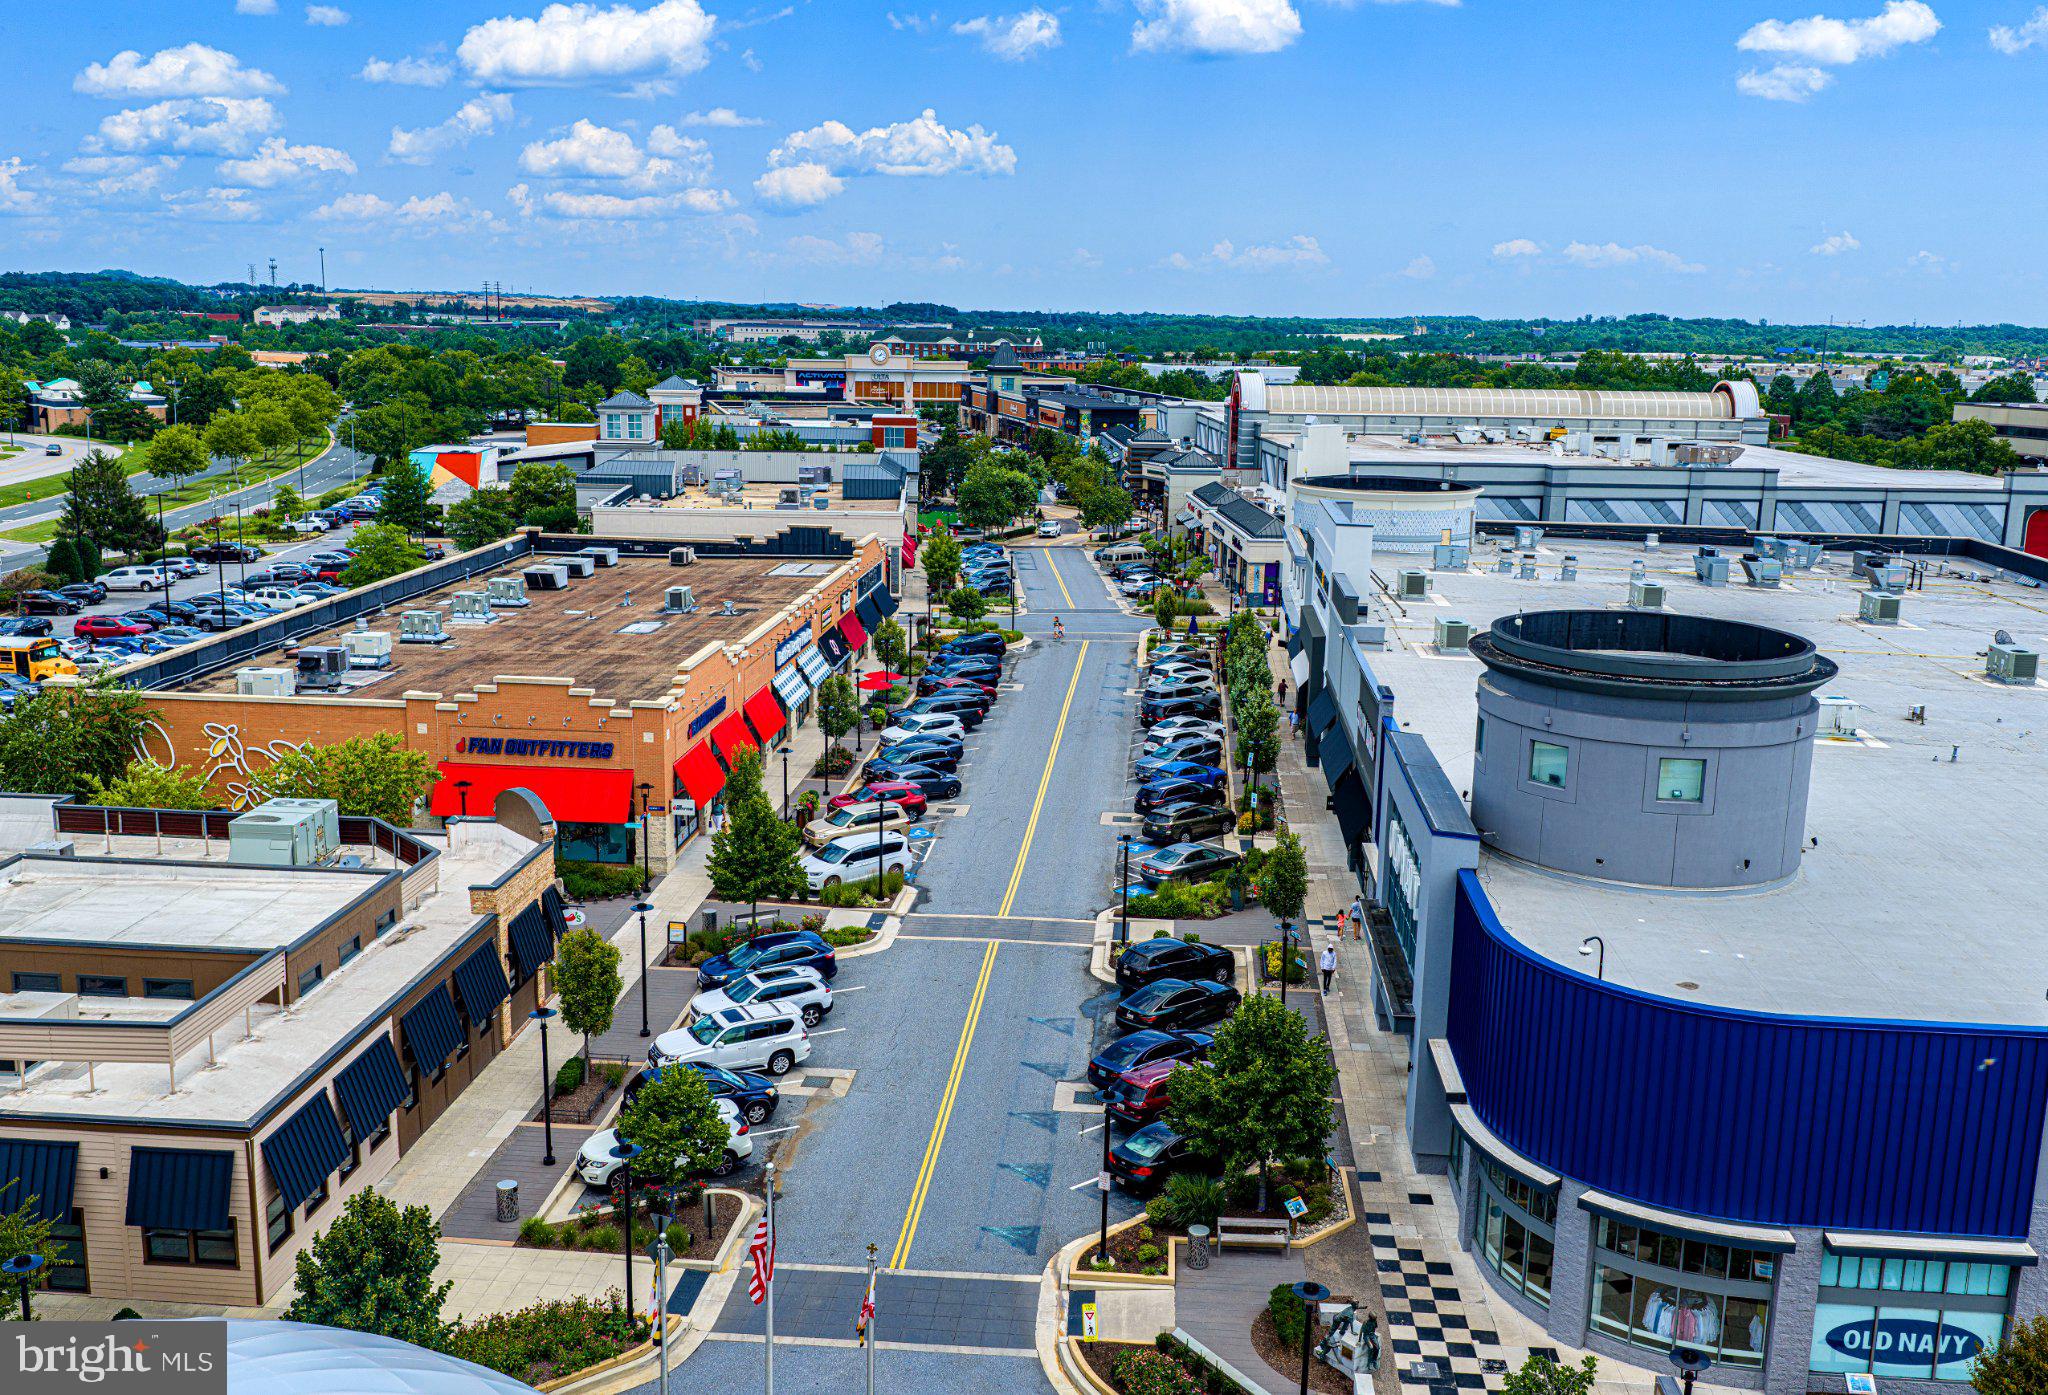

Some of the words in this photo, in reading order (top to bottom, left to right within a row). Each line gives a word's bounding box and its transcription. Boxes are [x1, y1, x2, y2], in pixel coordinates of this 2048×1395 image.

[468, 737, 504, 754] FAN
[504, 738, 615, 759] OUTFITTERS
[1843, 1329, 1893, 1351] OLD
[1898, 1332, 1970, 1355] NAVY
